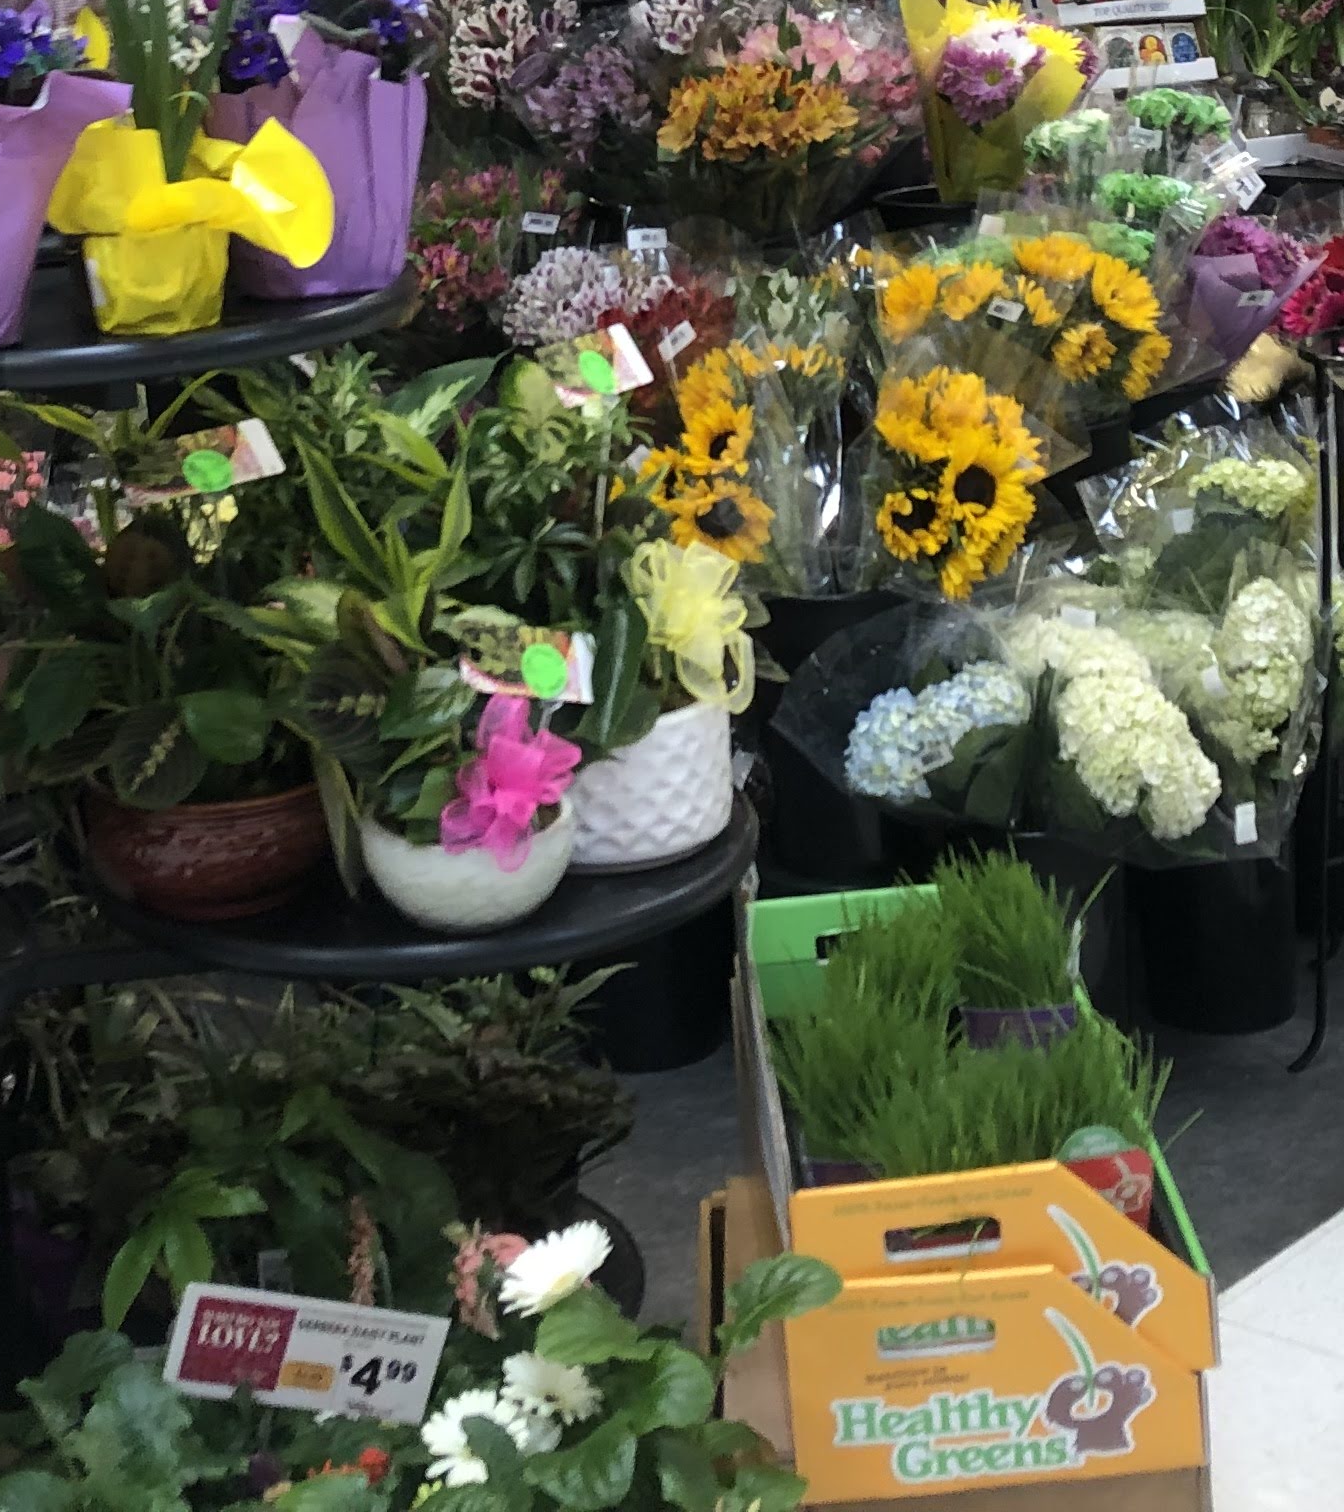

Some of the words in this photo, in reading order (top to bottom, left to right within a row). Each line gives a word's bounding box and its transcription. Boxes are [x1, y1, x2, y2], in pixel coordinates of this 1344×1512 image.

[1093, 6, 1110, 16] TOP
[1111, 3, 1147, 16] QUALITY
[832, 1389, 1041, 1446] Healthy
[894, 1436, 1072, 1481] Greens
